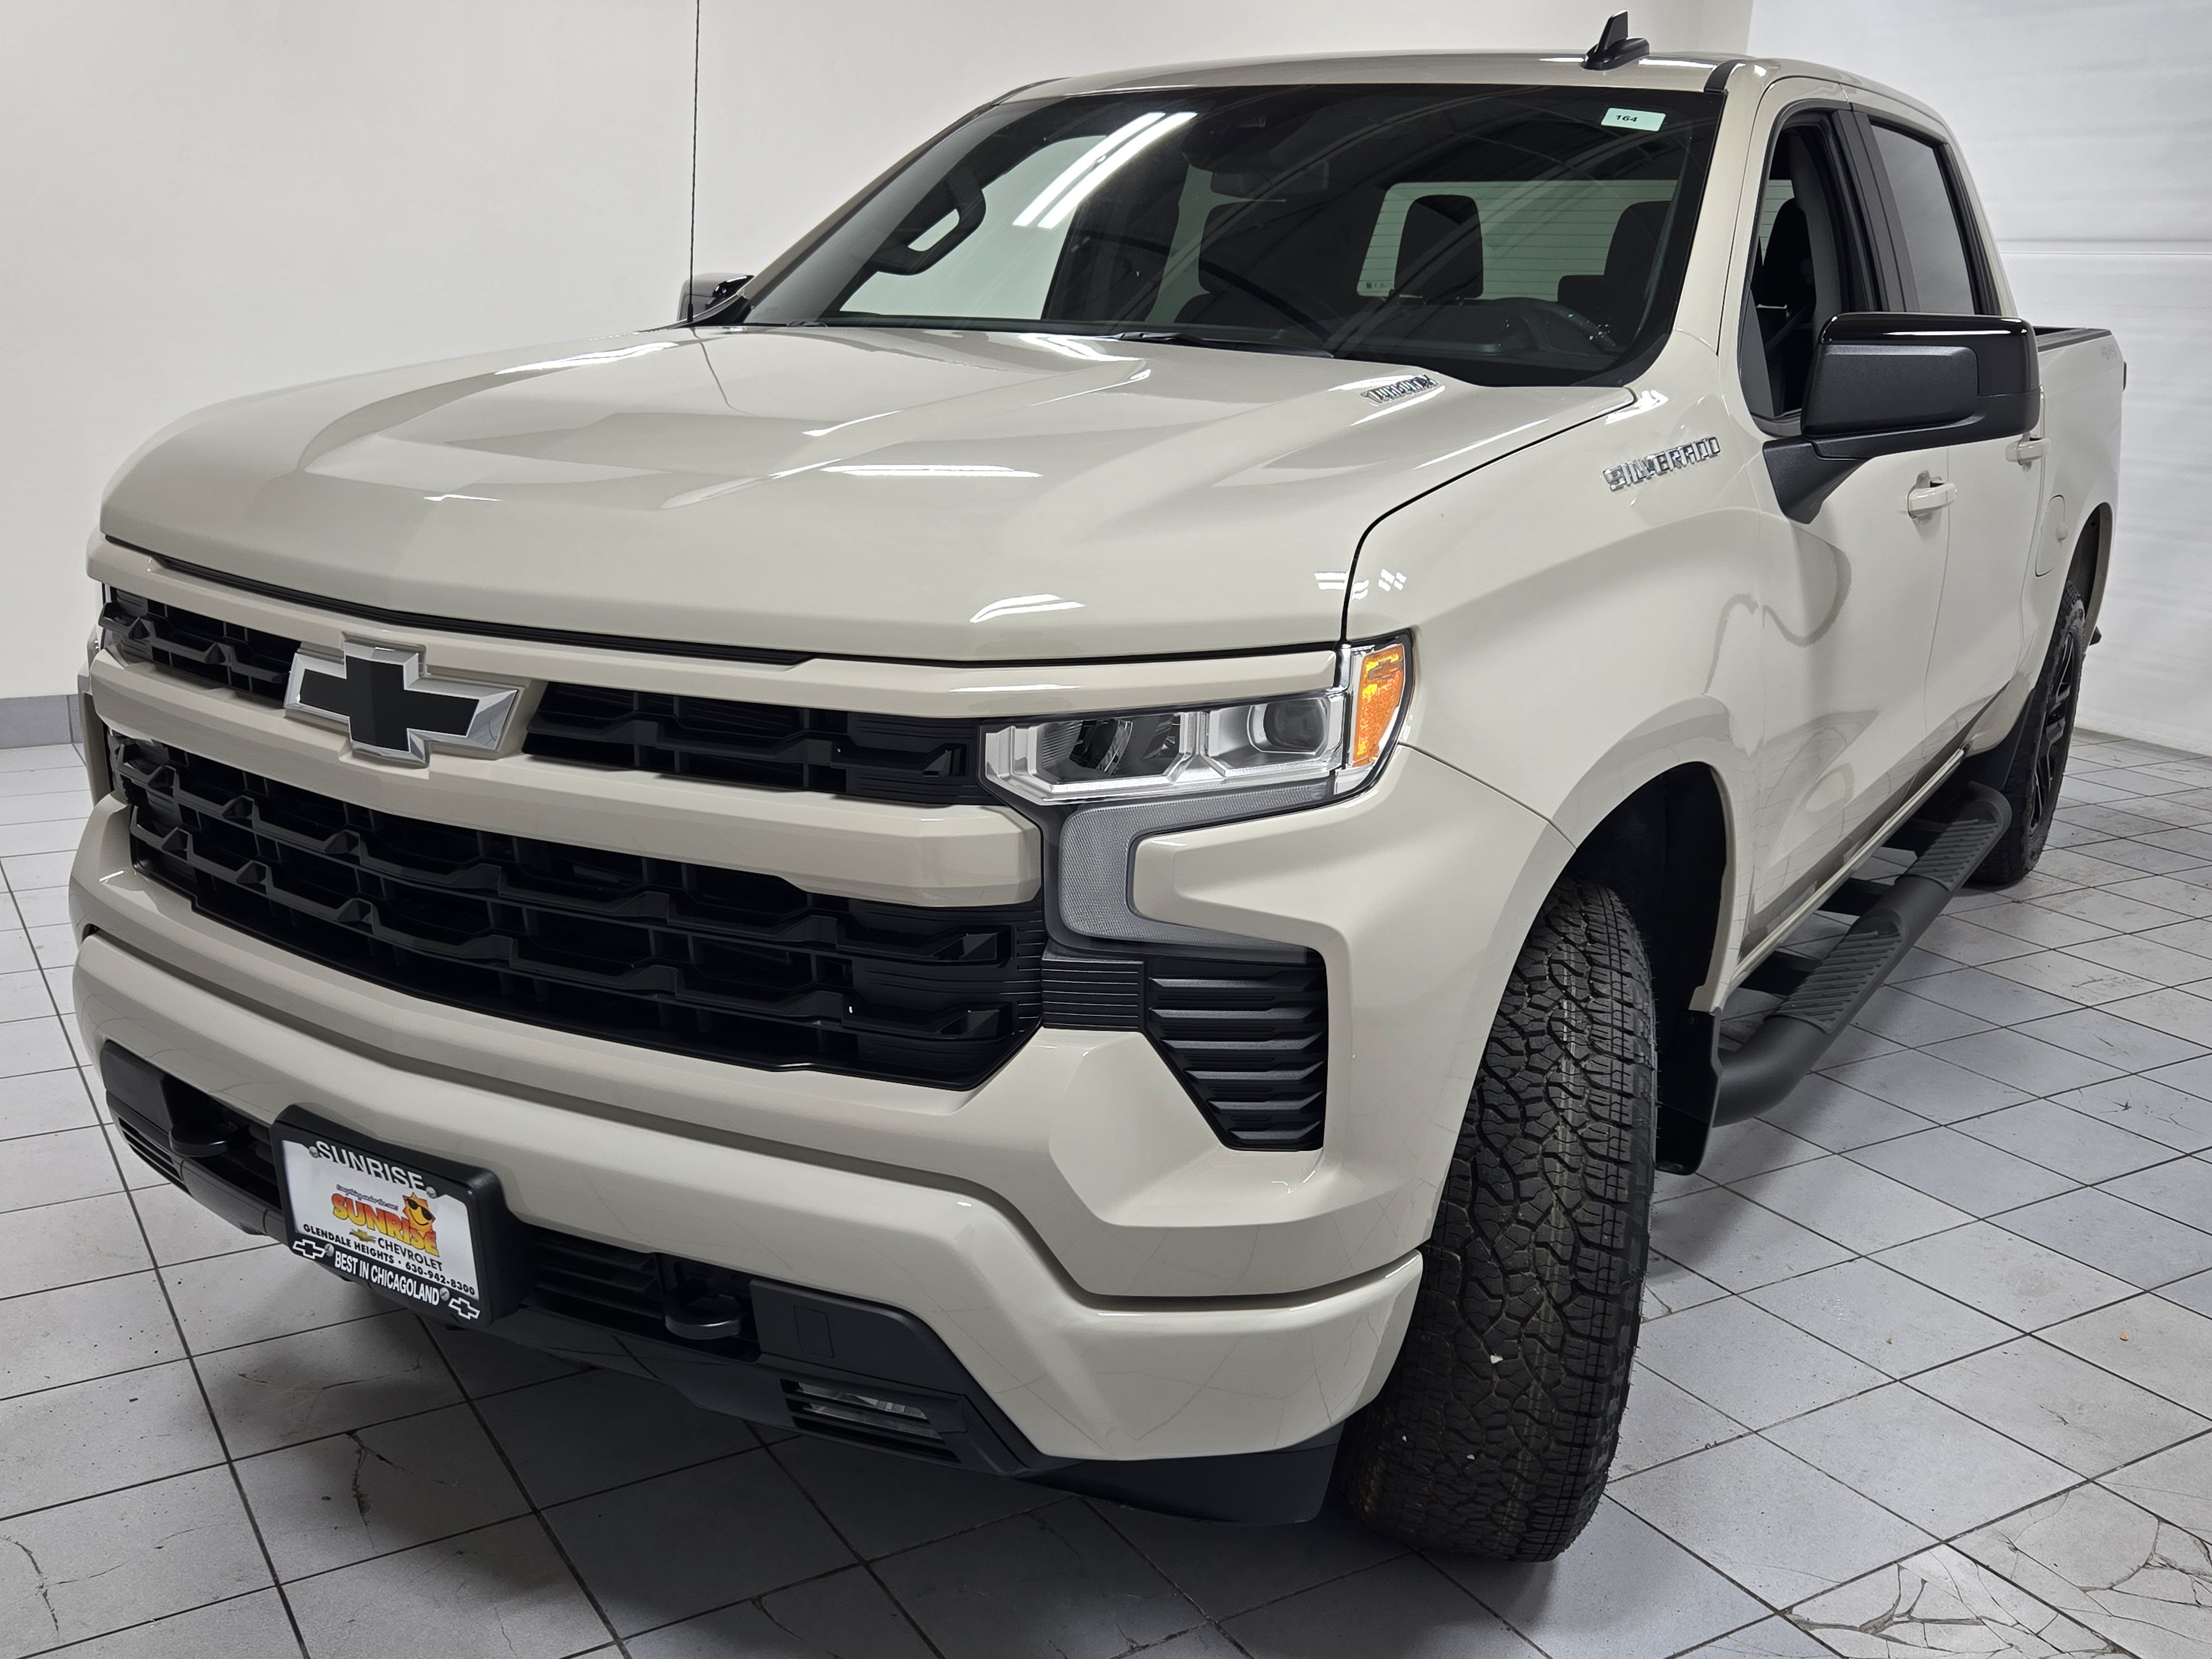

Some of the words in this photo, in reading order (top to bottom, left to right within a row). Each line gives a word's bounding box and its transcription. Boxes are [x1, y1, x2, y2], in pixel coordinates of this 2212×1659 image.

[1603, 436, 1721, 492] SILVERADO
[315, 1140, 426, 1191] SUNRISE
[331, 1193, 440, 1257] SUNRISE
[303, 1224, 352, 1248] GLENDALE
[354, 1241, 394, 1264] HEIGHTS
[405, 1262, 476, 1295] 630-942-8300
[335, 1250, 358, 1274] BEST
[359, 1260, 369, 1280] IN
[371, 1265, 440, 1306] CHICAGOLAND
[378, 1237, 442, 1271] CHEVROLET
